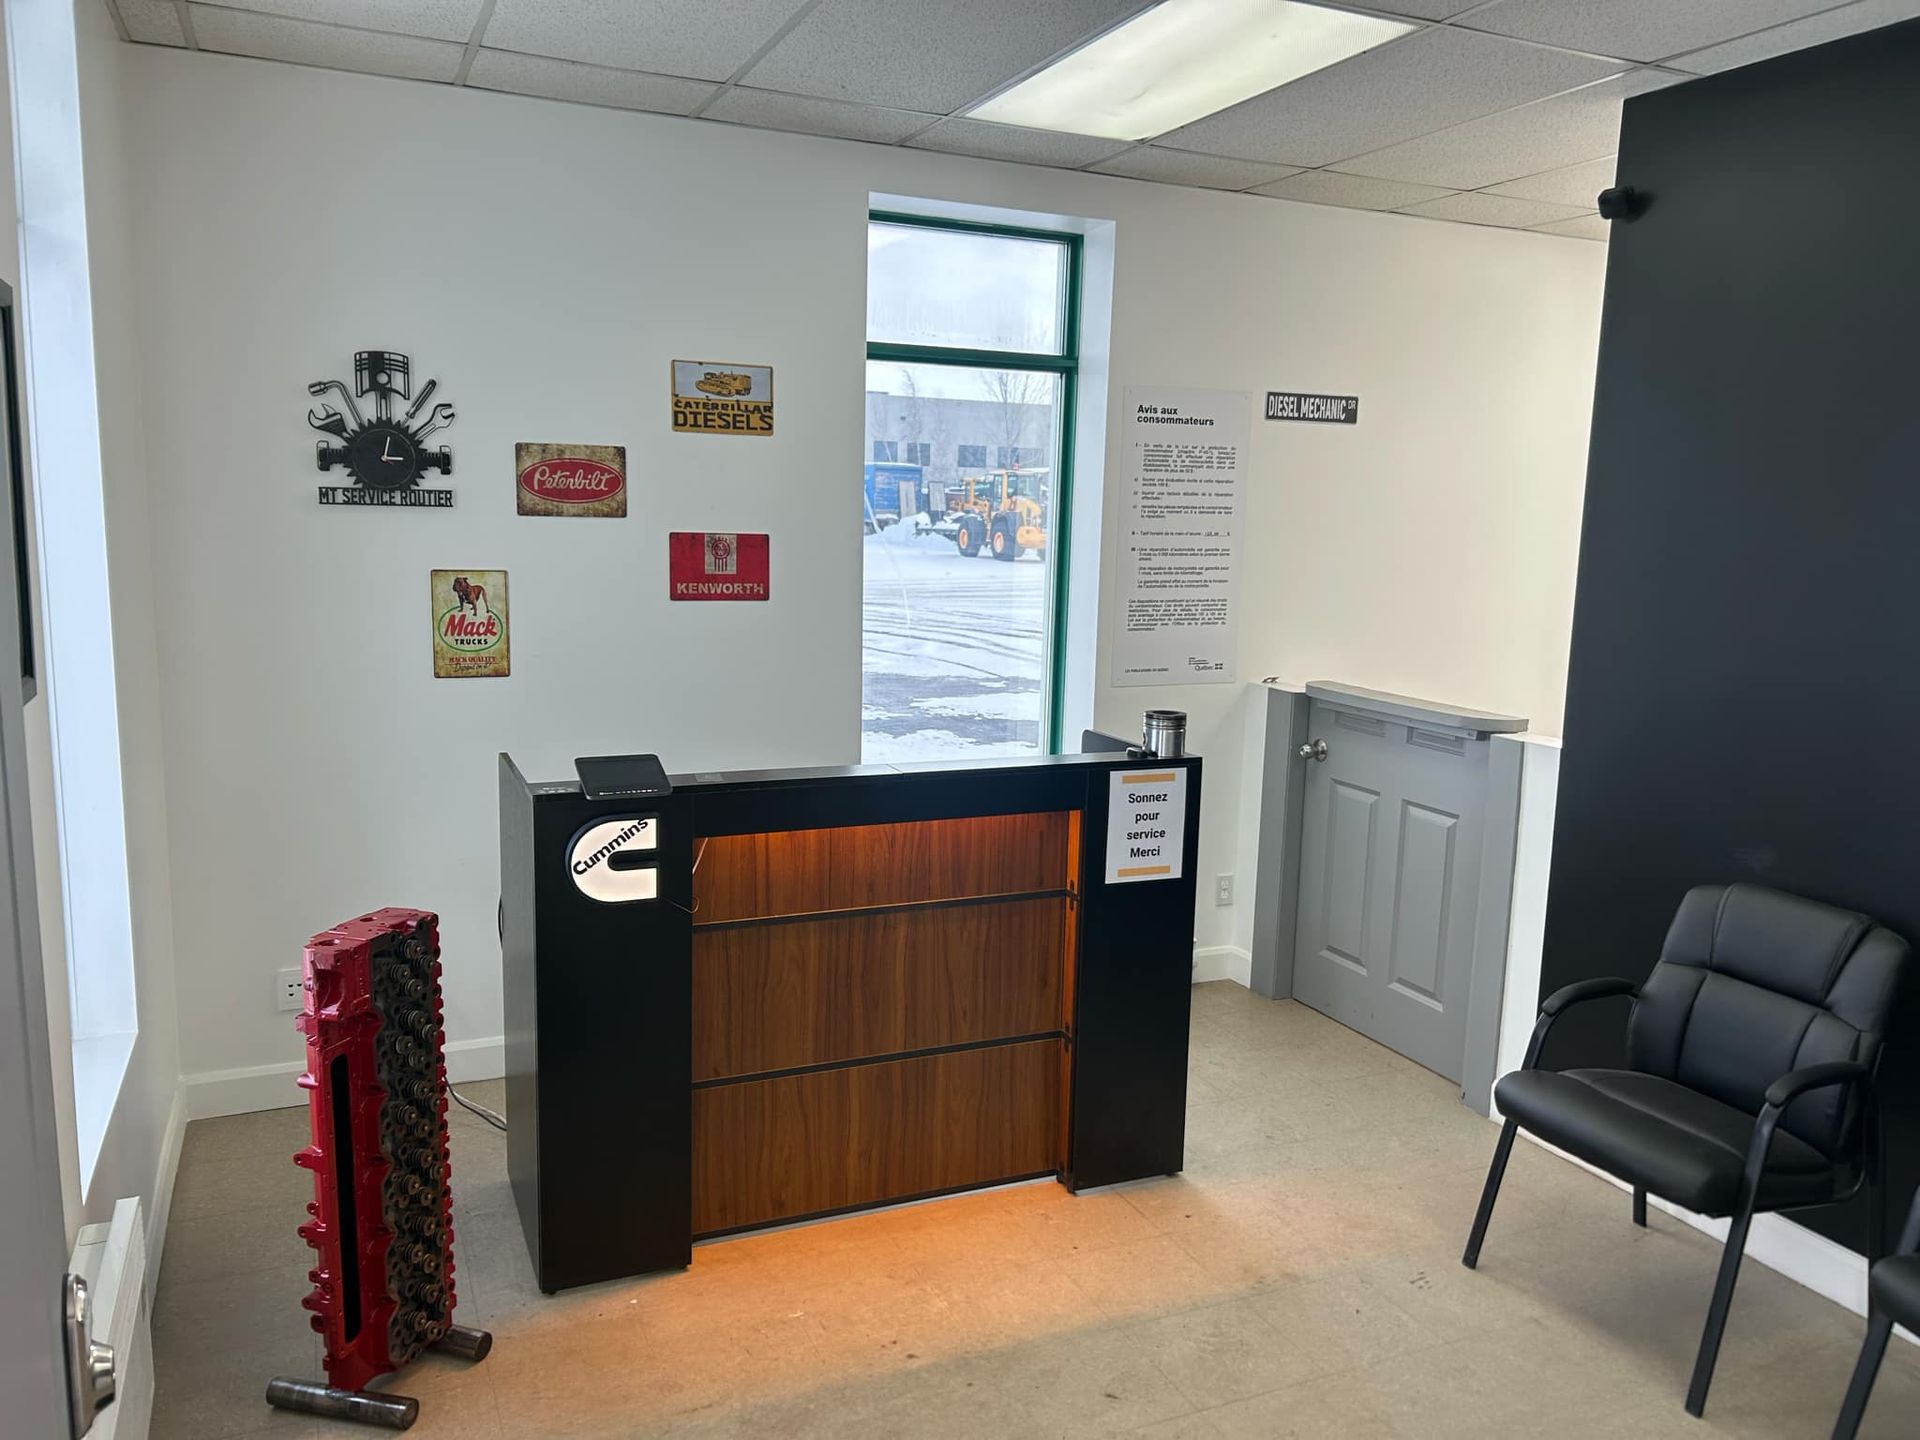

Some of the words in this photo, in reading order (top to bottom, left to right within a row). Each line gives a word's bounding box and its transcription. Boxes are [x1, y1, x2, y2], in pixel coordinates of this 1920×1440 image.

[674, 399, 773, 414] CATERPILLAR
[1137, 404, 1158, 414] Avis
[1160, 406, 1178, 415] aux
[1268, 395, 1299, 418] DIESEL
[1300, 397, 1346, 420] MECHANIC
[673, 411, 773, 431] DIESELS
[1137, 416, 1214, 426] consommateurs
[533, 465, 616, 491] Peterbilt
[318, 487, 338, 504] MT
[342, 488, 396, 506] SERVICE
[400, 490, 453, 507] ROUTIER
[676, 583, 765, 594] KENWORTH
[444, 613, 497, 637] Mack
[454, 638, 489, 646] TRUCKS
[1128, 793, 1169, 804] Sonnez
[1134, 811, 1161, 825] pour
[1126, 828, 1166, 841] service
[572, 819, 649, 875] Cummins
[1129, 845, 1161, 858] Merci
